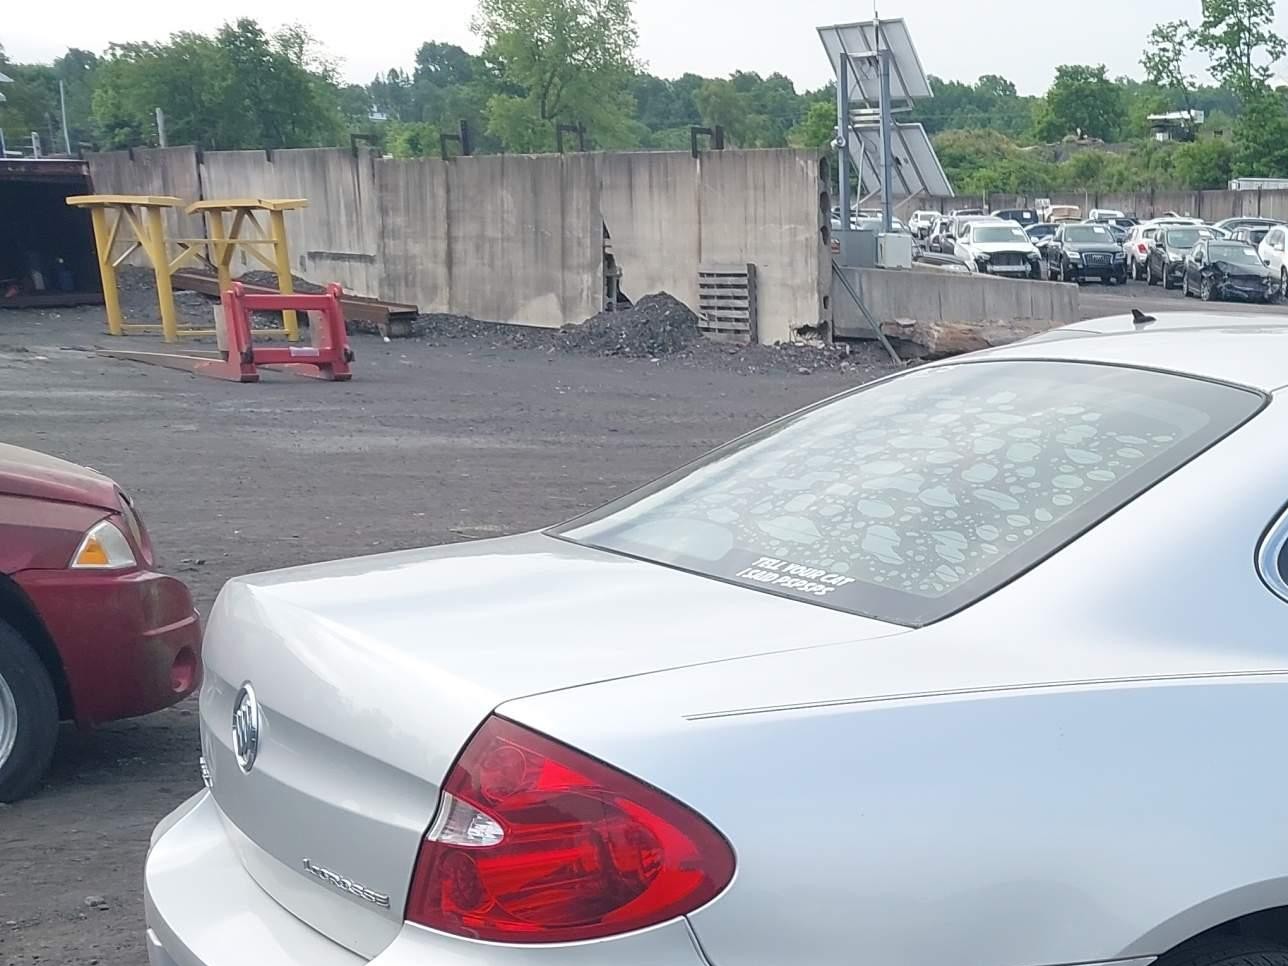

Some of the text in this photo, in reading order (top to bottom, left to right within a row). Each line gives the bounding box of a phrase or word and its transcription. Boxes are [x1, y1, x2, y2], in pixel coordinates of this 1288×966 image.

[744, 569, 780, 584] SAID
[772, 575, 835, 596] PSPSPS
[752, 556, 856, 587] TELL YOUR CAT
